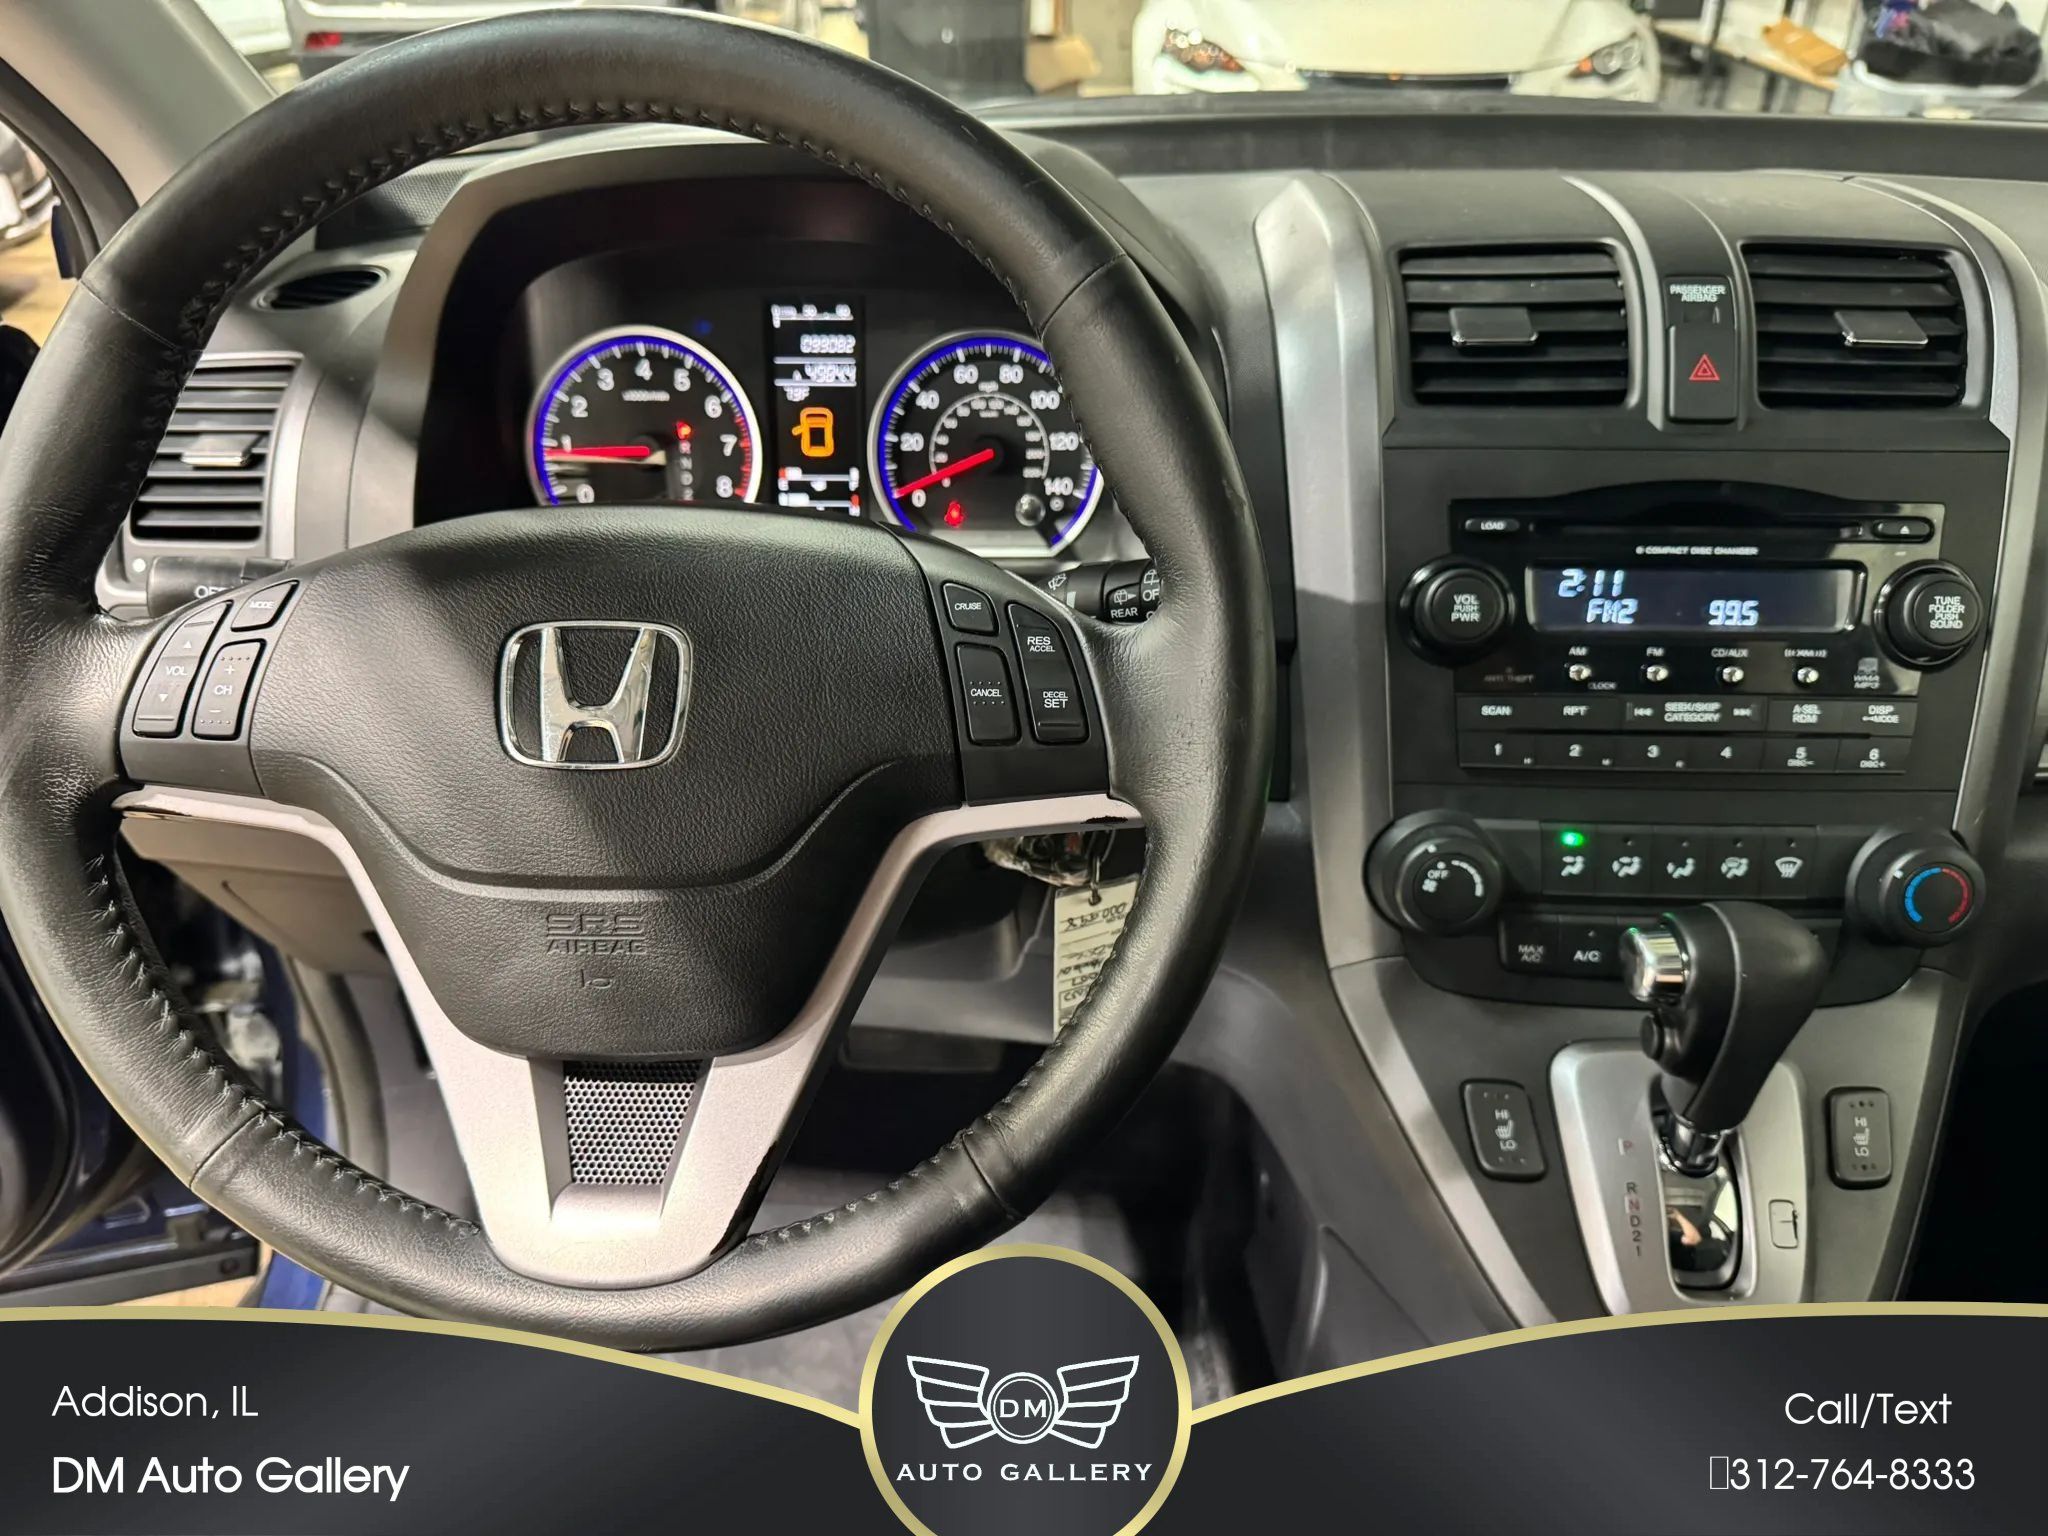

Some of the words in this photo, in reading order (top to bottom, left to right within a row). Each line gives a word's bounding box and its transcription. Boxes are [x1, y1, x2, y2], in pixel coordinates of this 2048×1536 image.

[1670, 284, 1726, 294] PASSENGER
[1681, 293, 1718, 302] AIRBAG
[634, 357, 653, 381] 4
[953, 364, 978, 384] 60
[999, 364, 1023, 384] 80
[597, 368, 615, 391] 3
[674, 368, 691, 391] 5
[916, 390, 940, 409] 40
[1030, 390, 1060, 410] 100
[571, 395, 589, 418] 2
[704, 395, 722, 418] 6
[561, 434, 572, 453] 1
[719, 434, 737, 456] 7
[900, 432, 924, 452] 20
[1049, 432, 1079, 451] 120
[716, 475, 733, 498] 8
[1044, 477, 1073, 496] 140
[576, 484, 594, 503] 0
[912, 489, 926, 507] 0
[1481, 521, 1506, 530] LOAD
[1558, 568, 1625, 597] 2:11
[1453, 594, 1479, 604] VOL
[1934, 596, 1961, 605] TUNE
[250, 601, 275, 610] MODE
[954, 602, 982, 611] CRUISE
[1453, 604, 1478, 612] PUSH
[1586, 598, 1638, 624] FM2
[1928, 604, 1965, 613] FOLDER
[1110, 607, 1138, 618] REAR
[1451, 613, 1480, 622] PWR
[1929, 620, 1963, 629] SOUND
[1027, 636, 1051, 646] RES
[1029, 645, 1055, 653] ACCEL
[1568, 646, 1588, 656] AM
[1646, 647, 1665, 657] FM
[1711, 648, 1749, 658] CD/AUX
[165, 665, 188, 677] VOL
[214, 685, 233, 696] CH
[1588, 682, 1618, 690] CLOCK
[970, 688, 1002, 697] CANCEL
[1043, 691, 1068, 699] DECEL
[1044, 699, 1068, 708] SET
[1664, 702, 1722, 711] SEEK/SKIP
[1481, 705, 1512, 716] SCAN
[1563, 705, 1589, 716] RPT
[1868, 705, 1894, 714] DISP
[1664, 712, 1722, 722] CATEGORY
[1792, 714, 1818, 723] RDM
[1494, 743, 1502, 756] 1
[1569, 744, 1583, 757] 2
[1647, 745, 1660, 758] 3
[1720, 746, 1733, 758] 4
[1795, 747, 1808, 759] 5
[1869, 748, 1880, 760] 6
[1427, 869, 1449, 879] OFF
[546, 914, 645, 935] SRS
[546, 939, 646, 955] AIRBAG
[1518, 945, 1544, 954] MAX
[1573, 950, 1601, 963] A/C
[1495, 1109, 1510, 1120] HI
[1854, 1117, 1868, 1127] HI
[1626, 1182, 1637, 1193] R
[1629, 1200, 1639, 1211] N
[1630, 1215, 1640, 1227] D
[1632, 1230, 1642, 1242] 2
